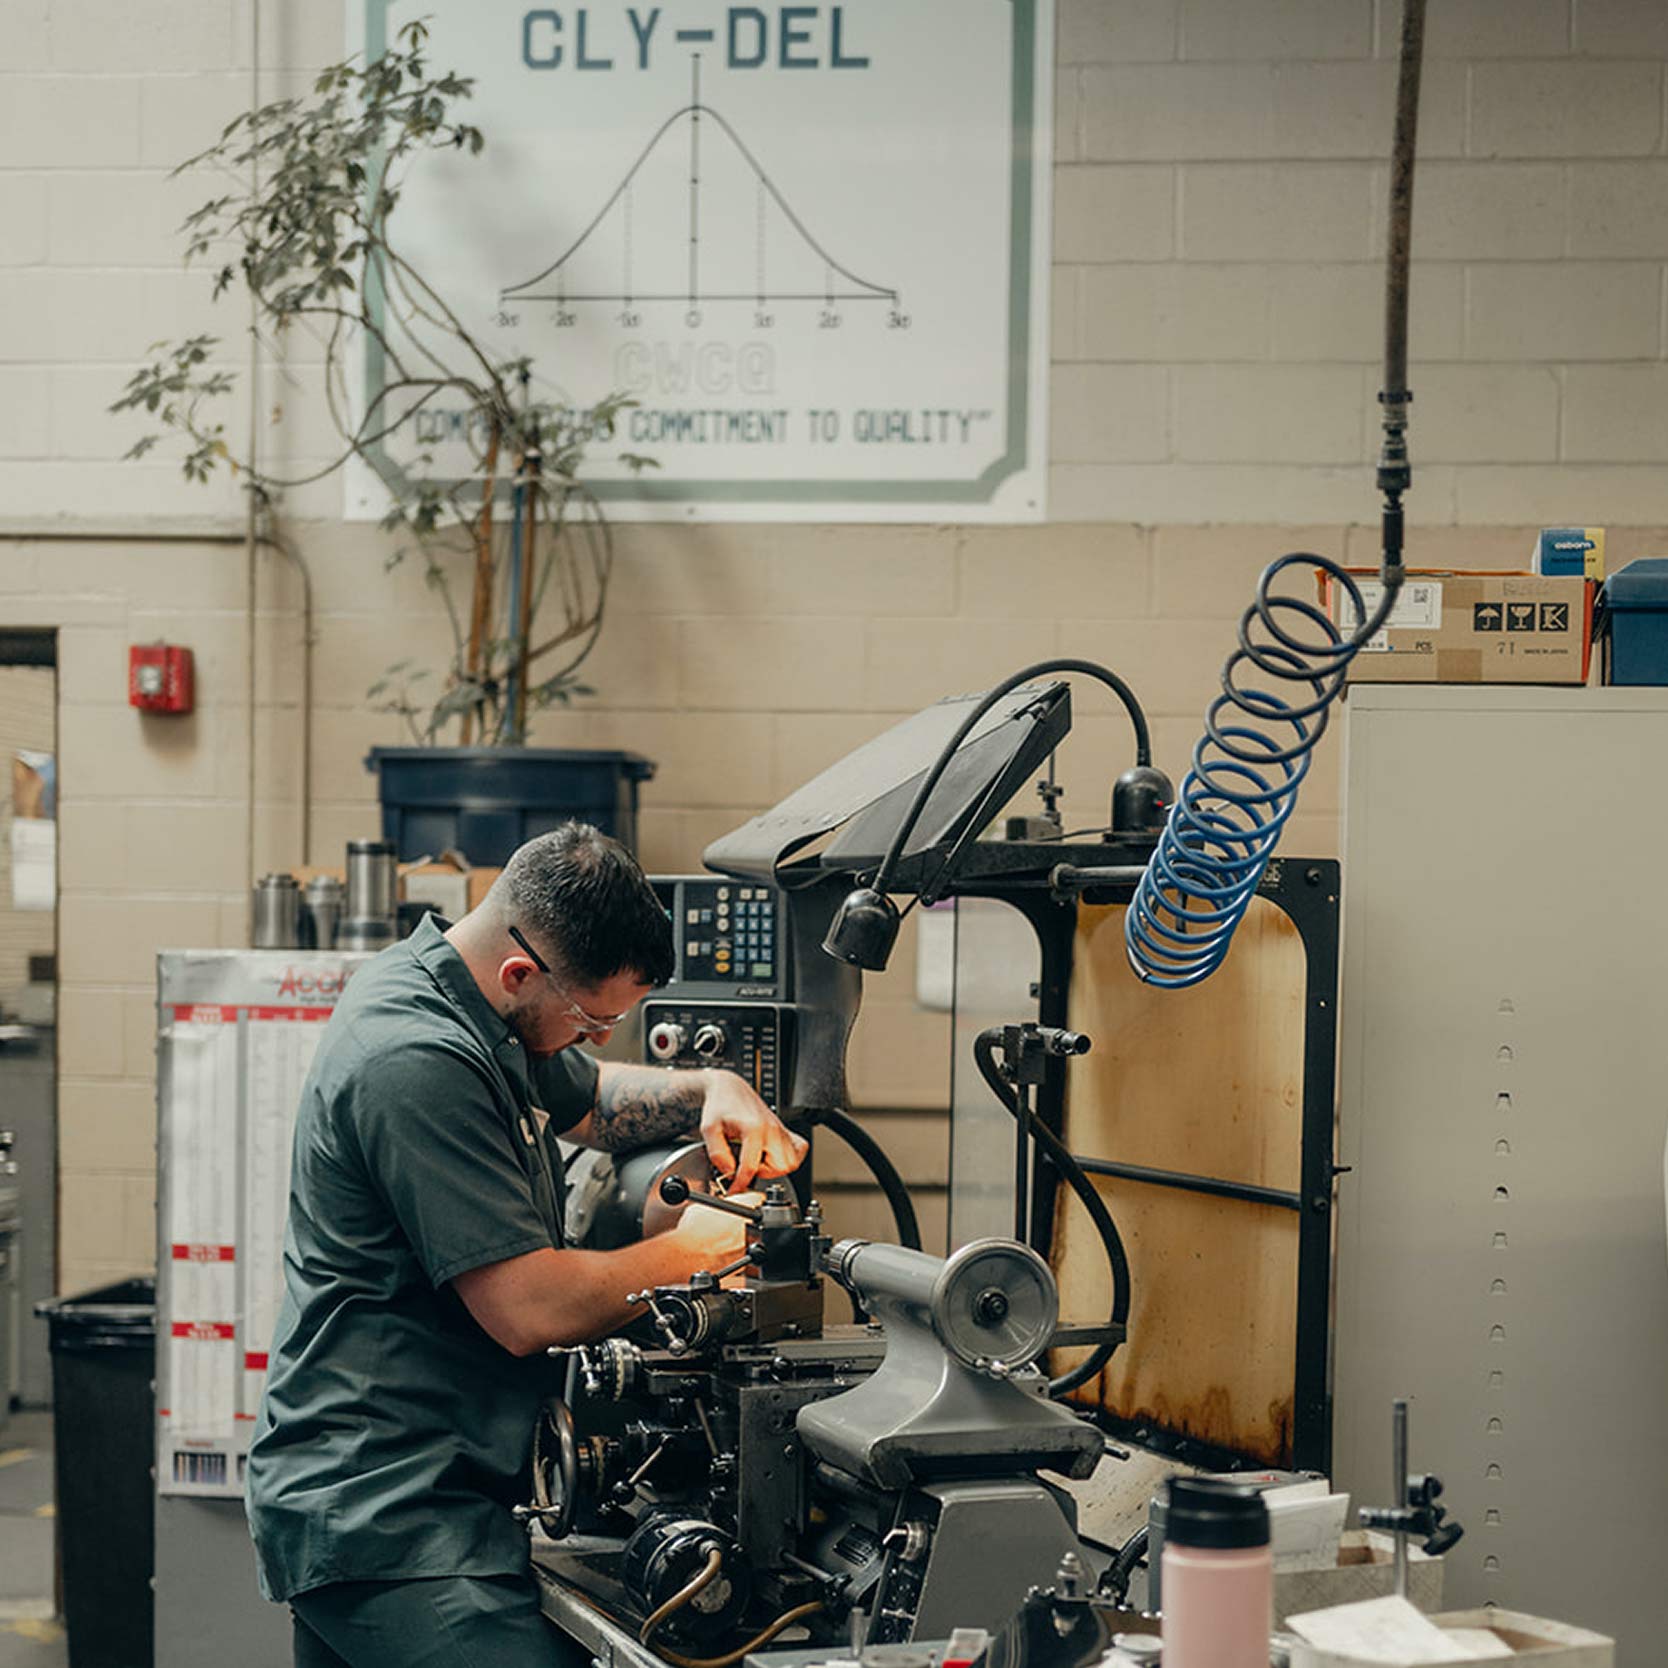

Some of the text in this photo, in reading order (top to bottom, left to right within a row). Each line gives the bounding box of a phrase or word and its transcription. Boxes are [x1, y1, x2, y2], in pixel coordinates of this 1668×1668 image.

[522, 7, 870, 70] CLY-DEL
[629, 409, 789, 443] COMMITMENT
[809, 409, 839, 443] TO
